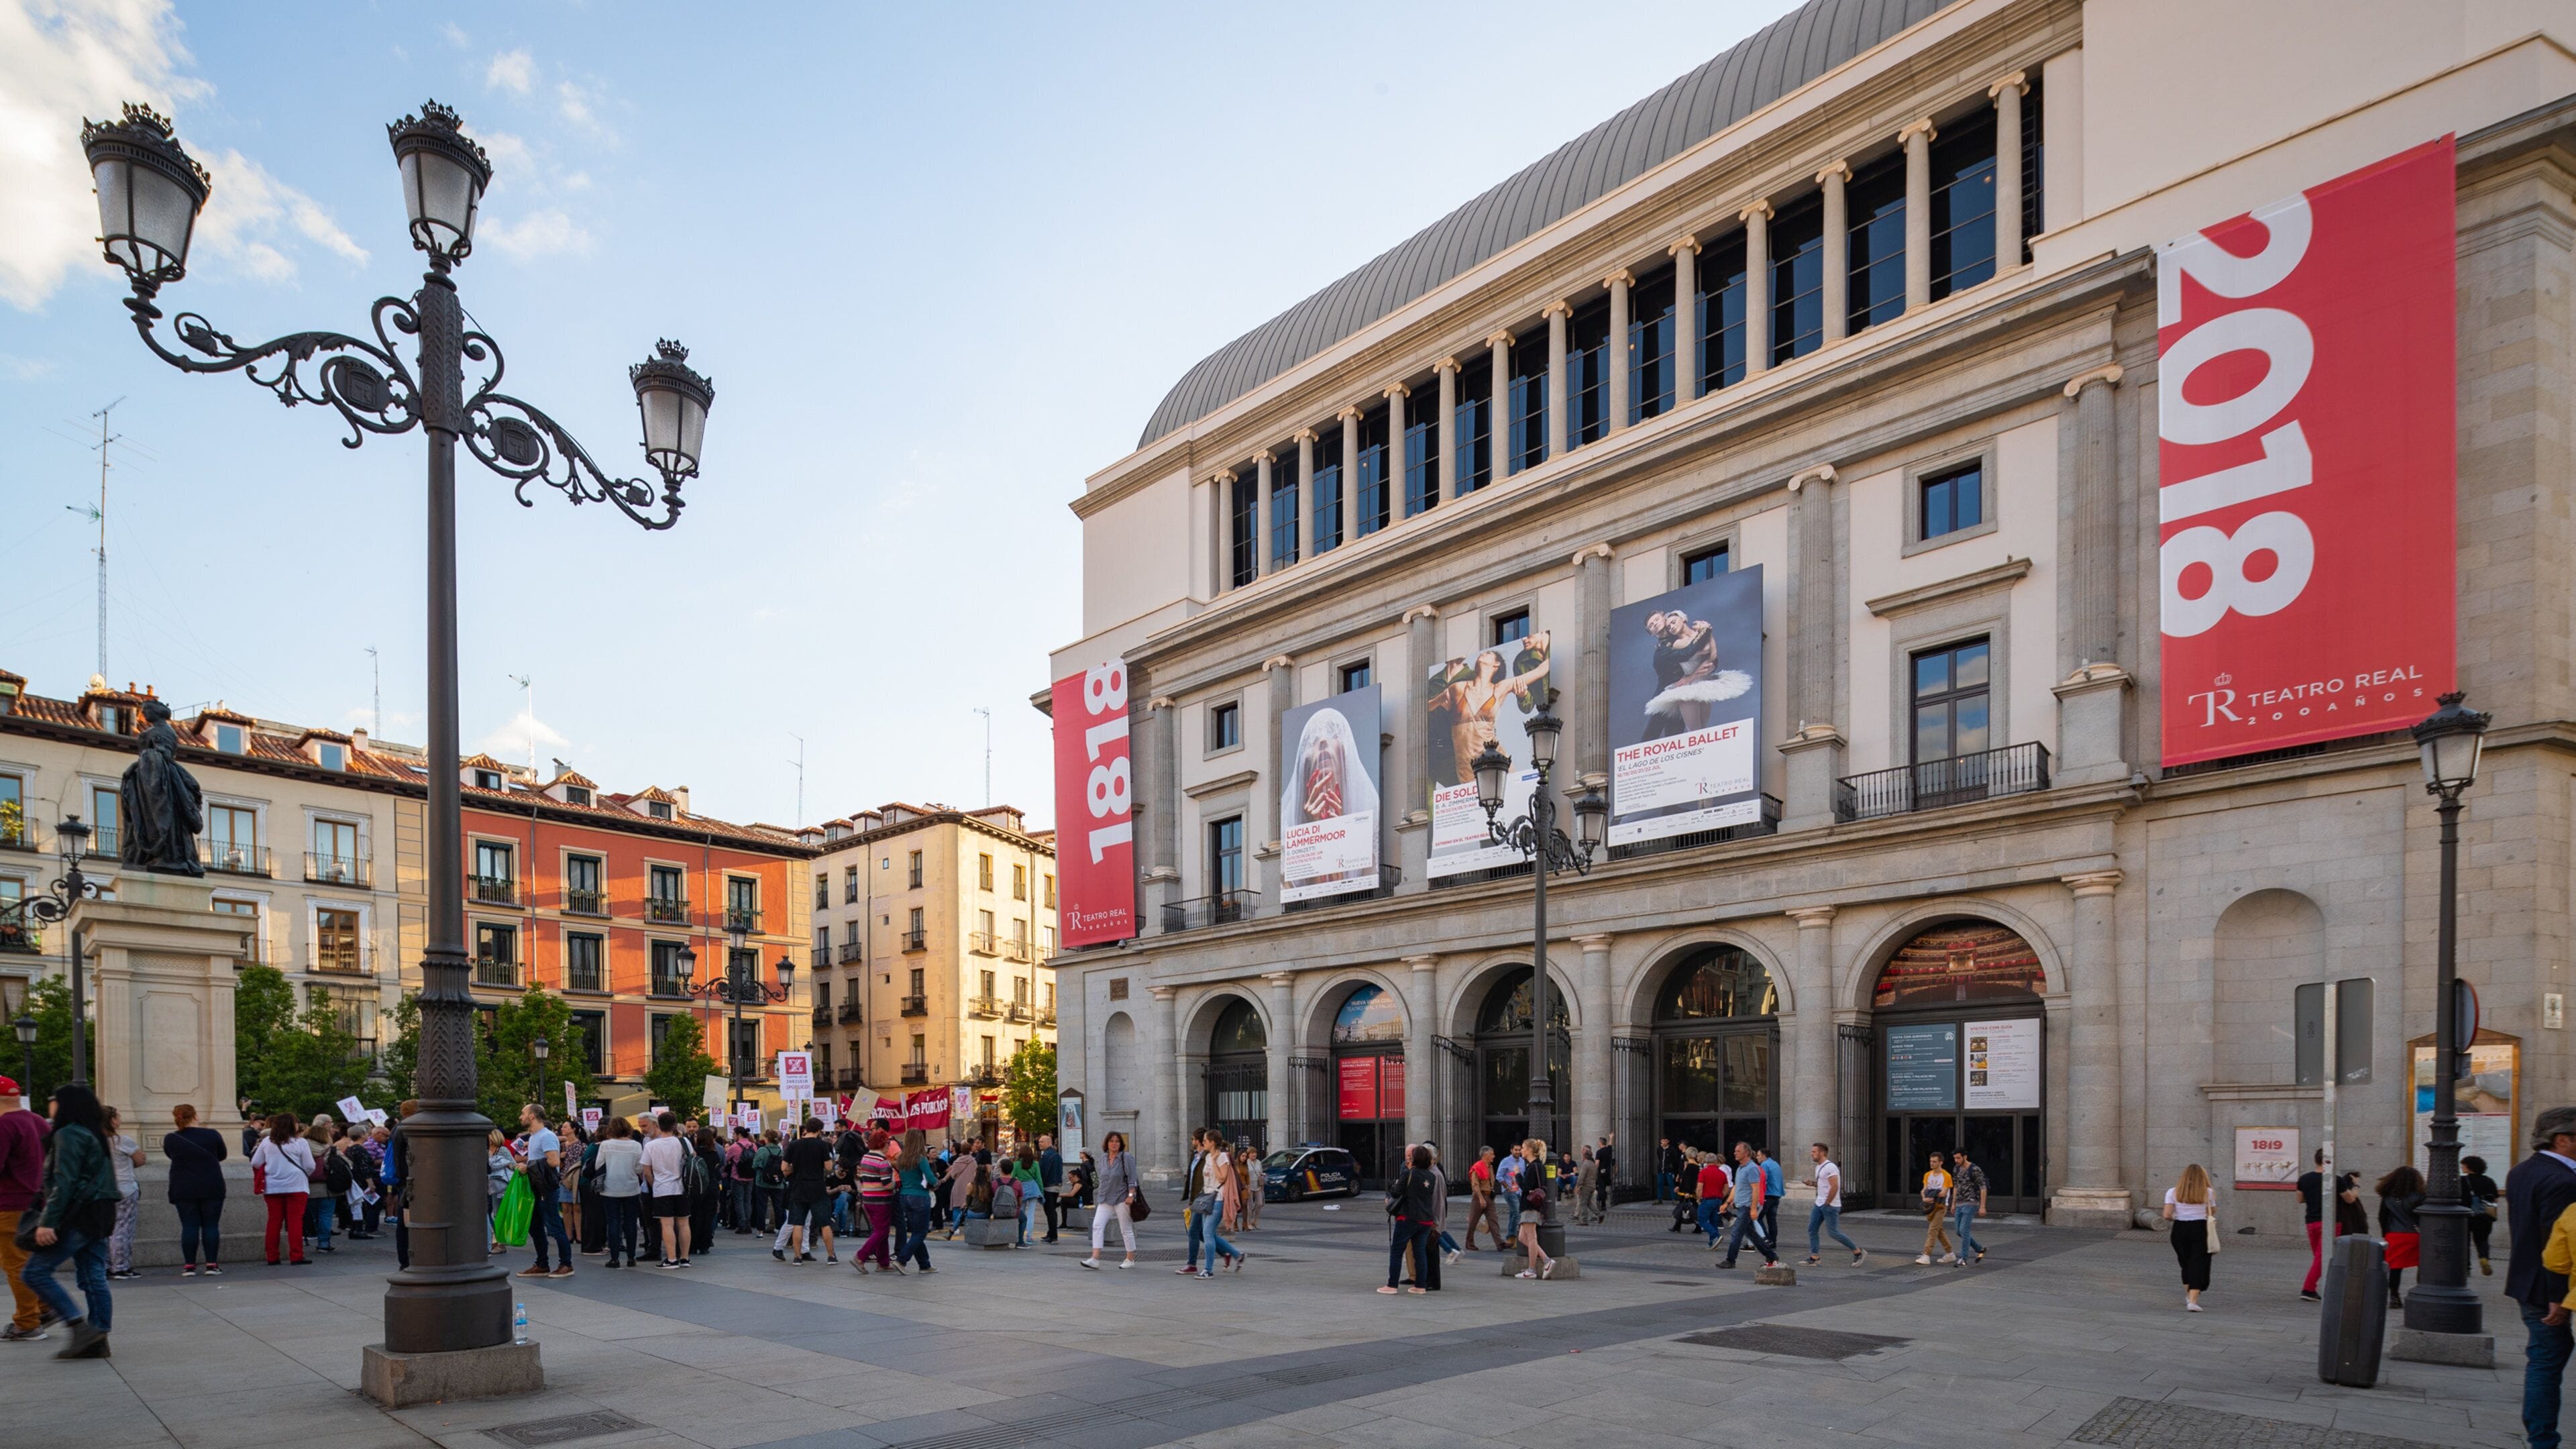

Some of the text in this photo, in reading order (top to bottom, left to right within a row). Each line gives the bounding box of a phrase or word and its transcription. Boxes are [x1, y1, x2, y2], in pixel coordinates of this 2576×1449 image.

[2157, 191, 2315, 637] 2018
[2247, 678, 2344, 707] TEATRO
[2355, 665, 2423, 688] REAL
[1617, 727, 1739, 762] THE ROYAL BALLET
[1083, 657, 1132, 865] 1818
[1628, 759, 1648, 769] LAGO
[1650, 757, 1659, 765] DE
[1660, 755, 1674, 763] LOS
[1436, 786, 1478, 803] DIE SOLD
[1448, 797, 1478, 807] ZIMMERMA
[1287, 824, 1320, 839] LUCIA DI
[1287, 830, 1346, 849] LAMMERMOOR
[1292, 847, 1316, 855] DONIZETTI
[1083, 911, 1108, 922] TEATRO
[1110, 908, 1127, 918] REAL
[910, 1104, 920, 1116] ES
